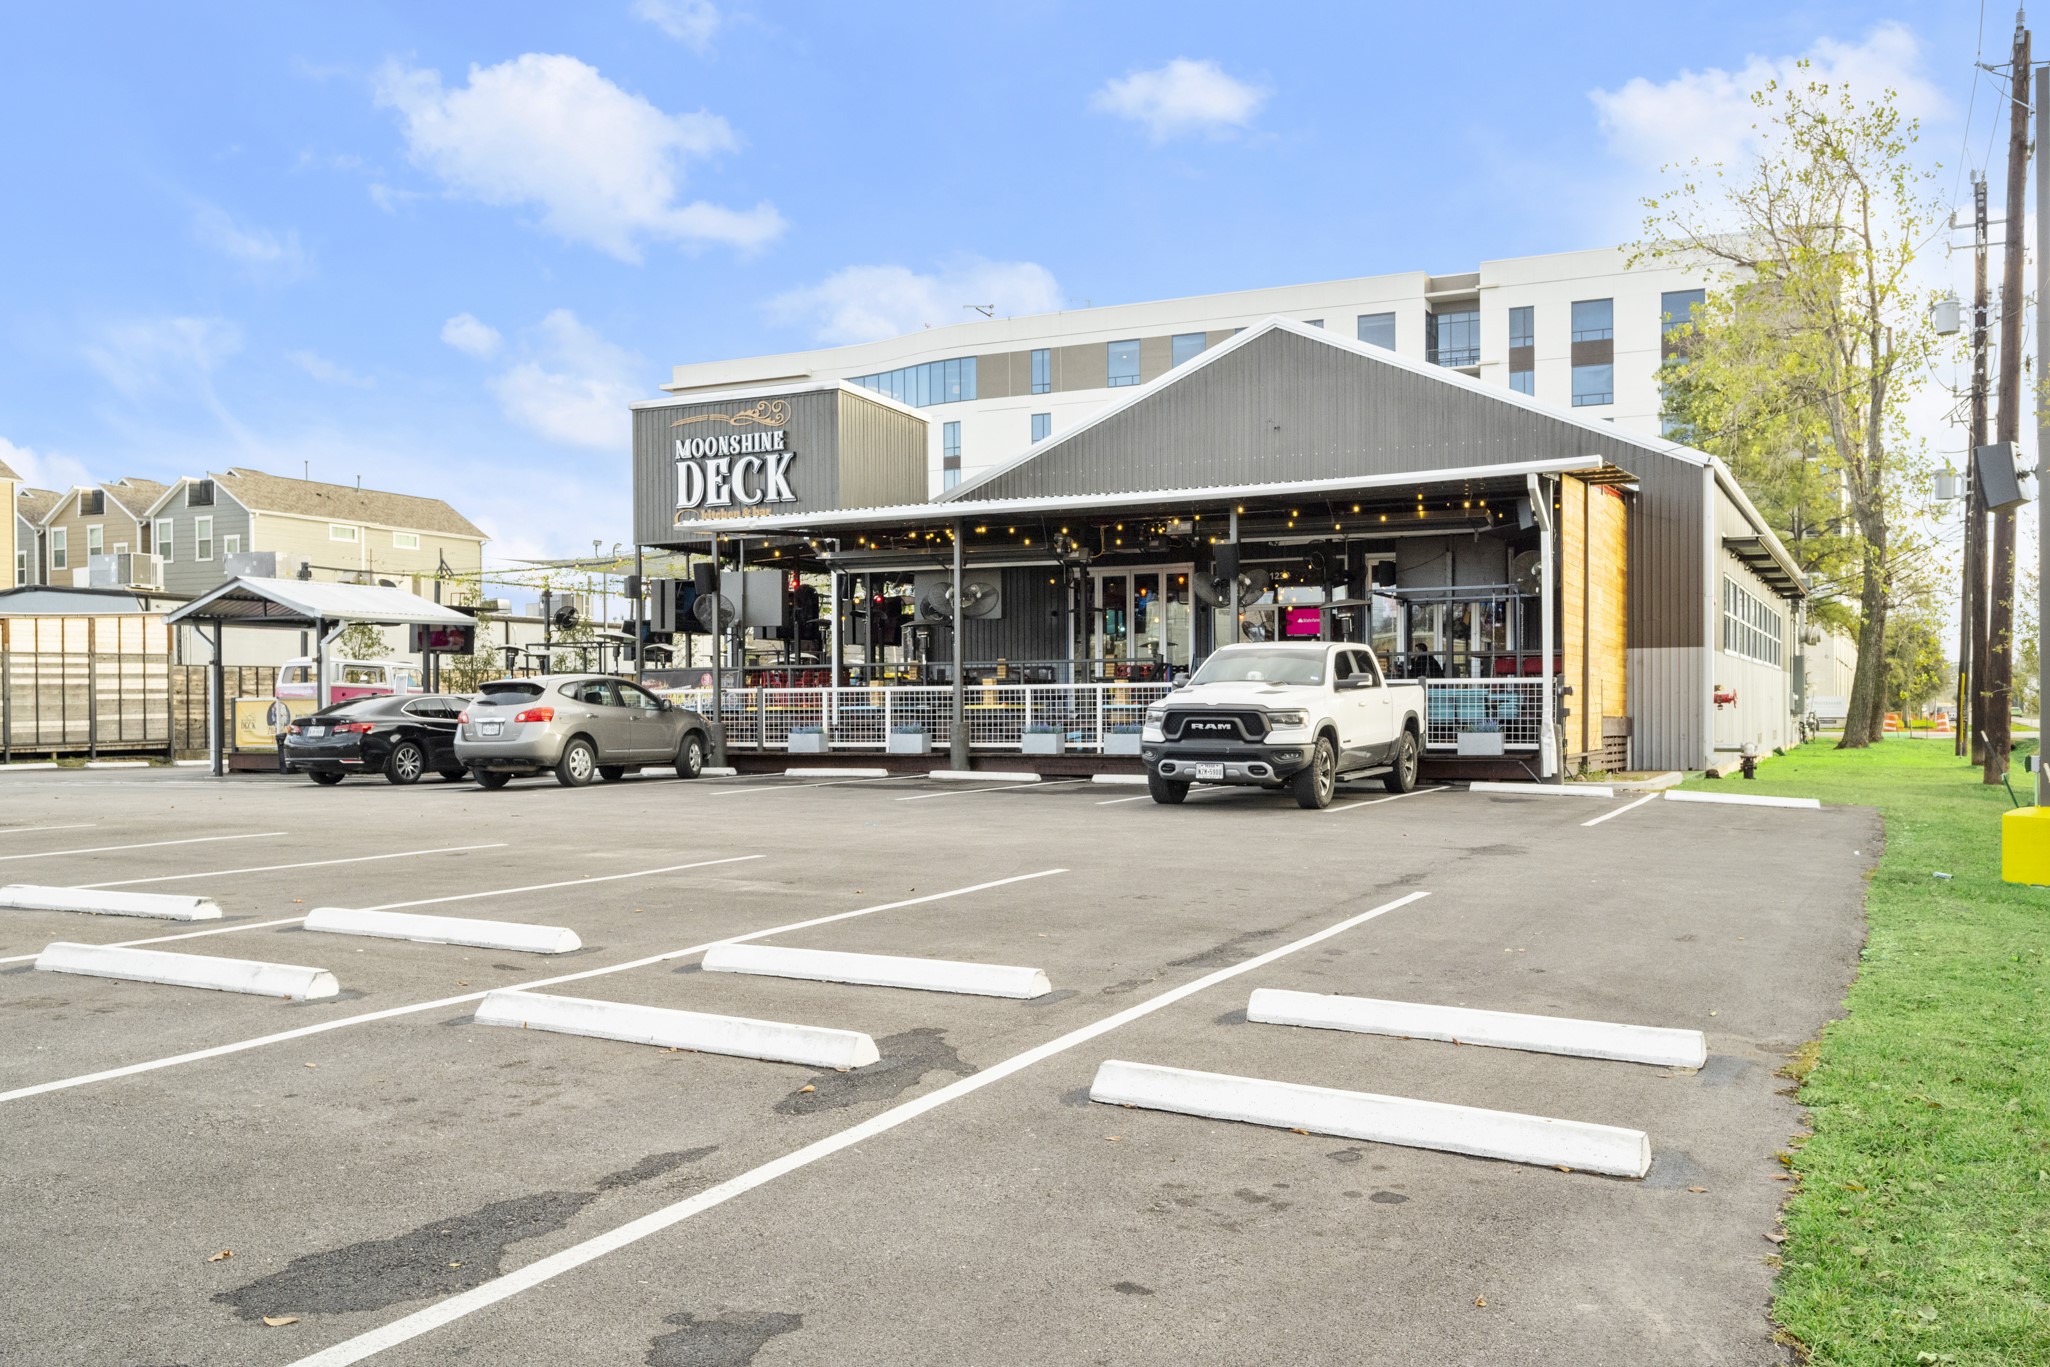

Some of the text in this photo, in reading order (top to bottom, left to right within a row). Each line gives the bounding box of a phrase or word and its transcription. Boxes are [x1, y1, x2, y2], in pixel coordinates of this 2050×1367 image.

[675, 430, 785, 460] MOONSHINE
[675, 452, 798, 509] DECK
[701, 508, 740, 520] kitchen
[752, 505, 771, 517] bar
